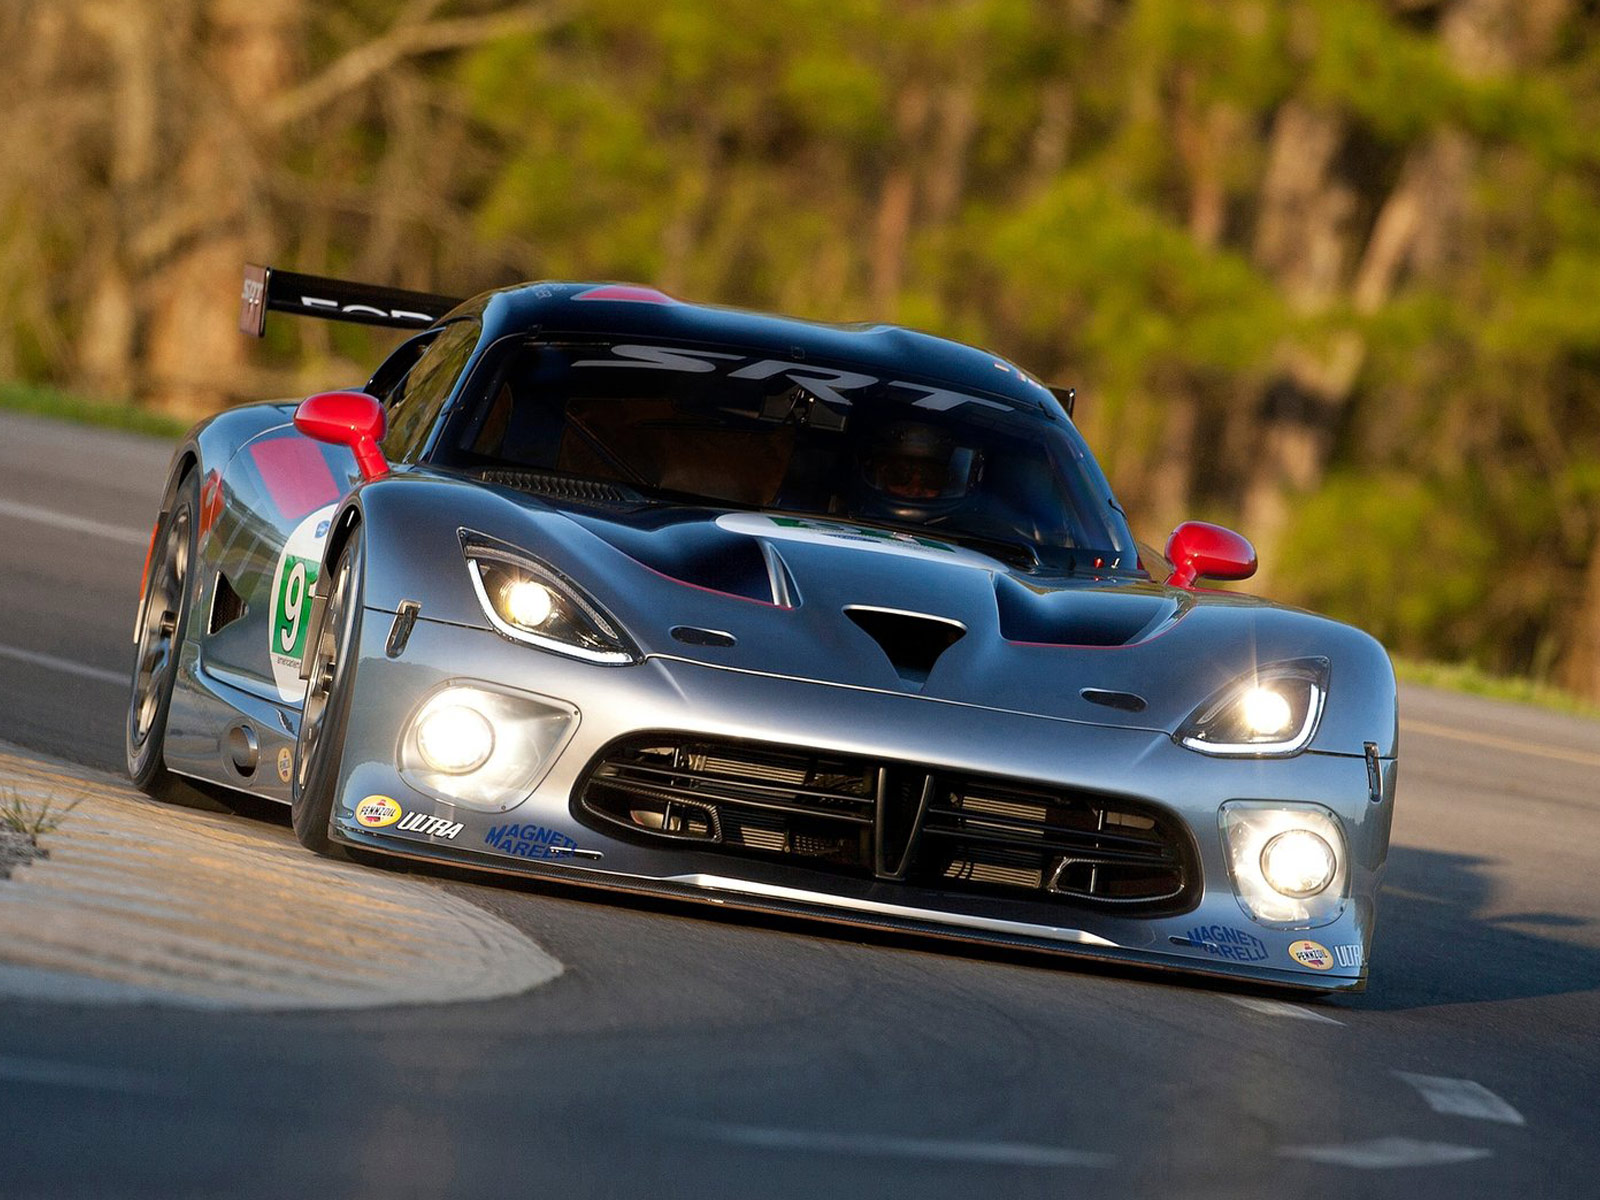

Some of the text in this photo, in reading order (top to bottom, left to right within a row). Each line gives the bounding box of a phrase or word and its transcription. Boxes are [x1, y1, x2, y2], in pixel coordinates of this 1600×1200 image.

[571, 344, 1015, 411] SRT
[360, 804, 397, 817] PENNZOIL
[397, 811, 465, 840] ULTRA
[485, 824, 577, 850] MAGNETI
[1186, 925, 1267, 951] MAGNETI
[1296, 948, 1329, 961] PENNZOIL
